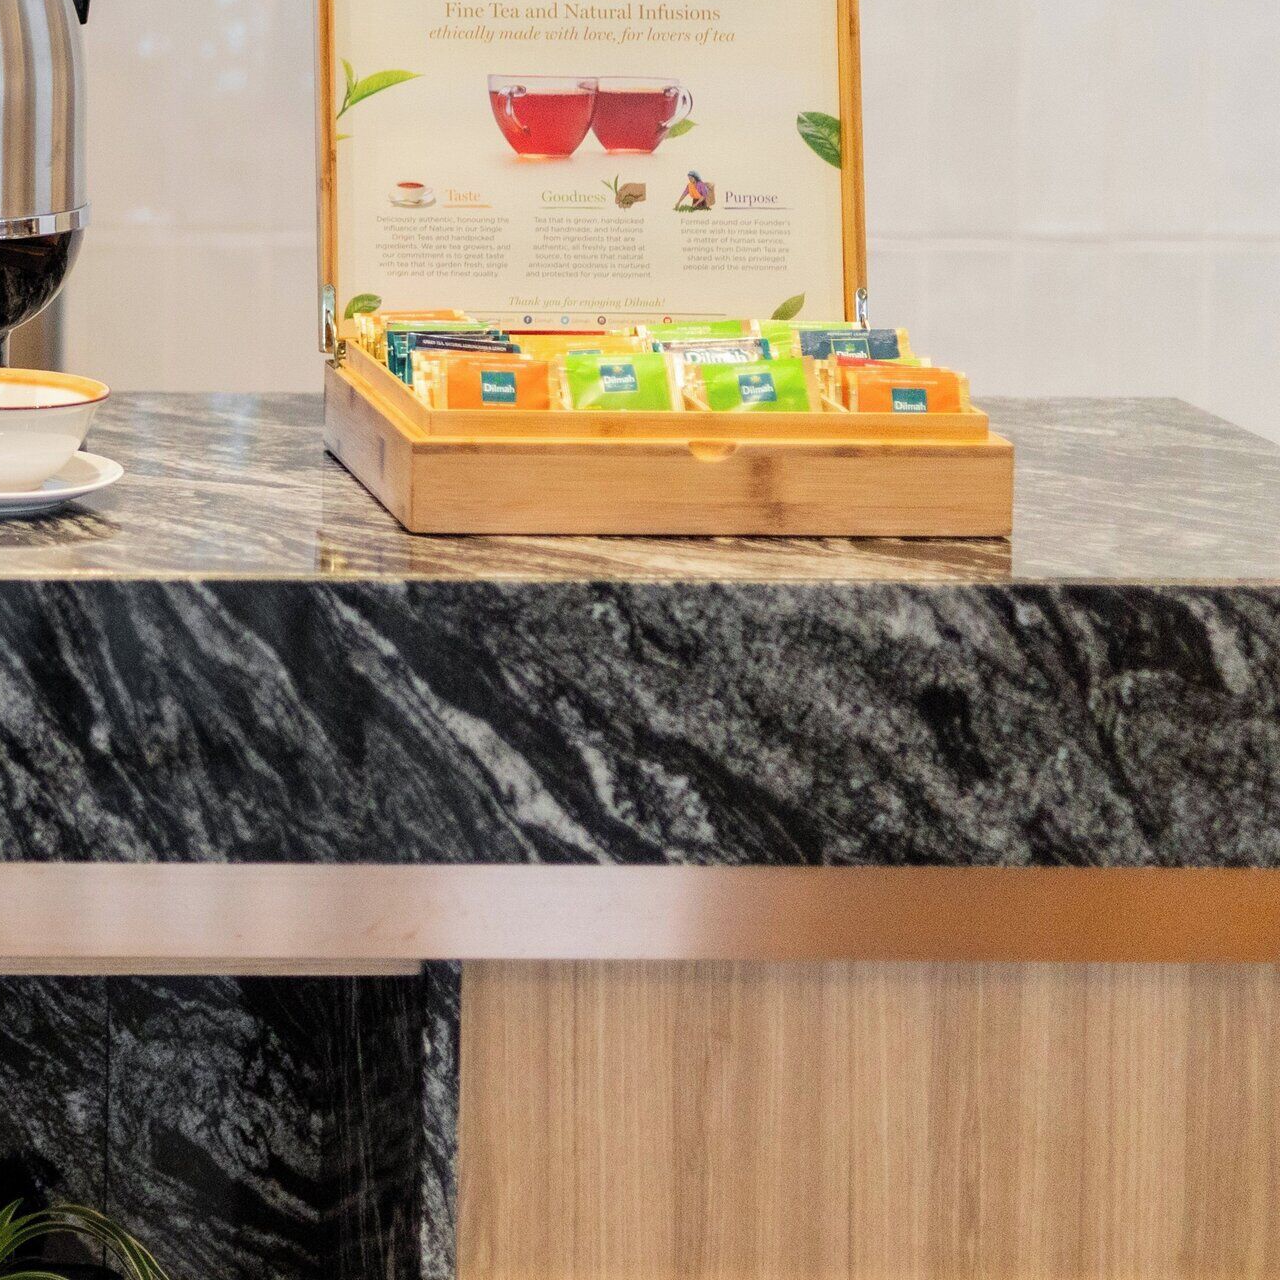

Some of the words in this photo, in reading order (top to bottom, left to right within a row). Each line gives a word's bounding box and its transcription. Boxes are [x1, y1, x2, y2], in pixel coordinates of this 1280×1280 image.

[445, 2, 484, 18] Fine
[489, 3, 519, 19] Tea
[525, 2, 558, 19] and
[564, 3, 632, 20] Natural
[638, 4, 720, 20] Infusions
[428, 25, 495, 42] ethically
[499, 26, 540, 40] made
[545, 27, 578, 40] with
[583, 28, 616, 42] love,
[618, 28, 643, 44] for
[646, 28, 691, 42] lovers
[694, 28, 712, 45] of
[713, 31, 736, 42] tea
[446, 188, 481, 202] Taste
[541, 189, 607, 204] Goodness
[724, 190, 779, 207] Purpose
[509, 296, 541, 307] Thank
[543, 299, 560, 310] you
[561, 296, 578, 310] for
[580, 297, 622, 310] enjoying
[624, 297, 666, 307] Dilmah!
[603, 375, 635, 384] Dilmah
[483, 383, 515, 393] Dilmah
[741, 385, 774, 395] Dilmah
[894, 401, 926, 411] Dilmah
